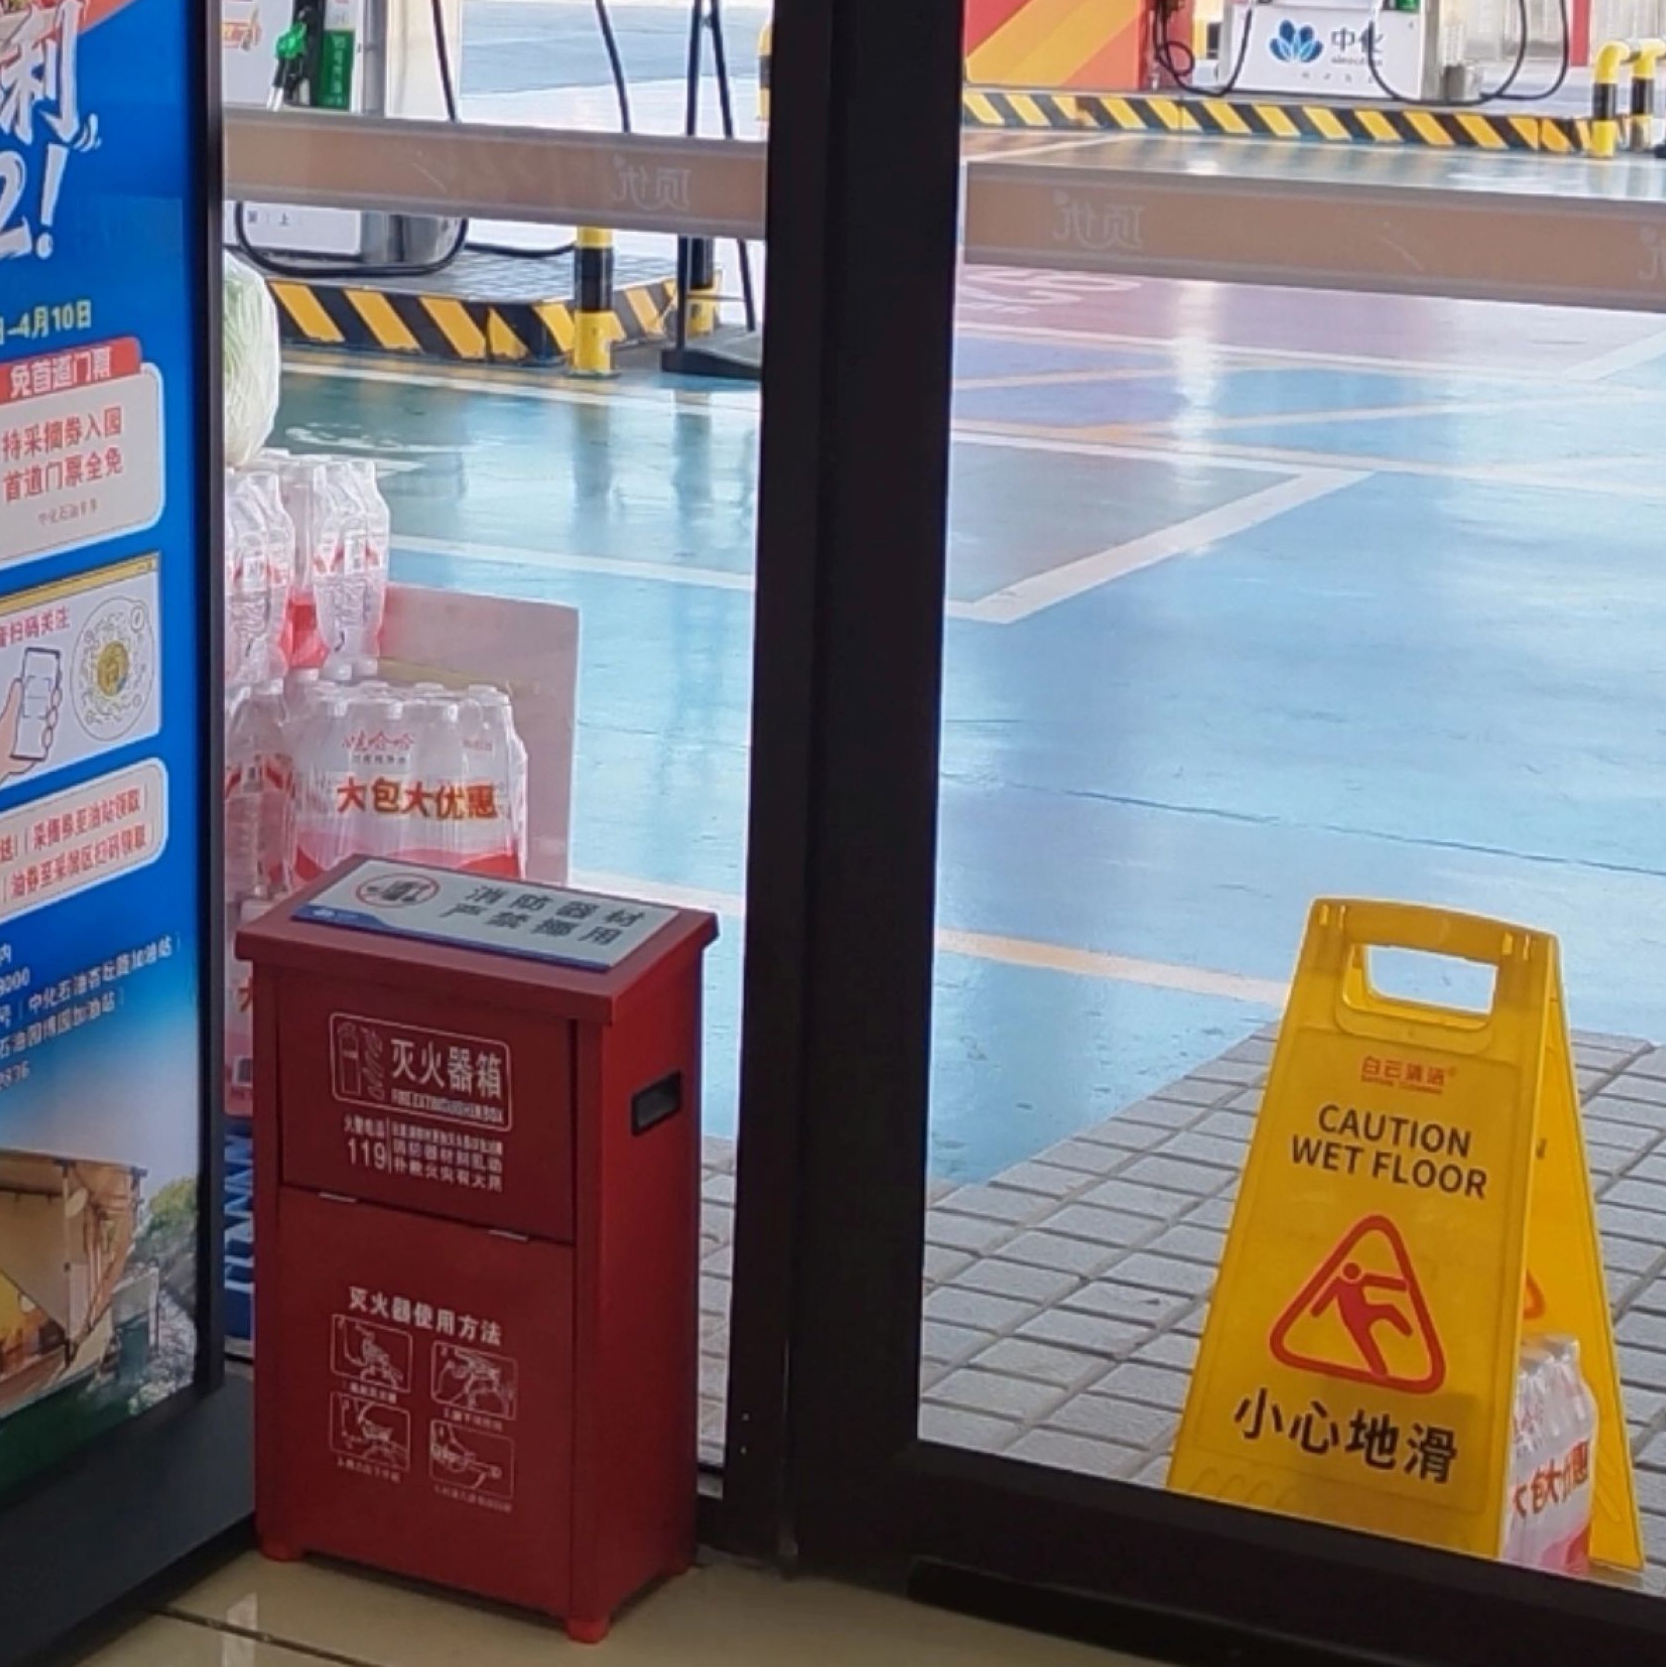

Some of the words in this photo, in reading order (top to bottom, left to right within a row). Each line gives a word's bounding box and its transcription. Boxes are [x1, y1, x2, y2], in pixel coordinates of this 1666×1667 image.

[9, 345, 111, 399] 免首道门票
[2, 407, 122, 462] 持采摘券入园
[3, 446, 123, 504] 首道门票全免
[336, 775, 499, 821] 大包大优惠
[439, 901, 623, 946] 严禁挪用
[464, 884, 646, 928] 消防器材
[390, 1038, 503, 1101] 灭火器箱
[348, 1136, 386, 1170] 119
[1318, 1103, 1472, 1158] CAUTION
[1292, 1133, 1365, 1175] WET
[1371, 1150, 1488, 1200] FLOOR
[348, 1285, 502, 1347] 灭火器使用方法
[1234, 1386, 1458, 1485] 小心地滑
